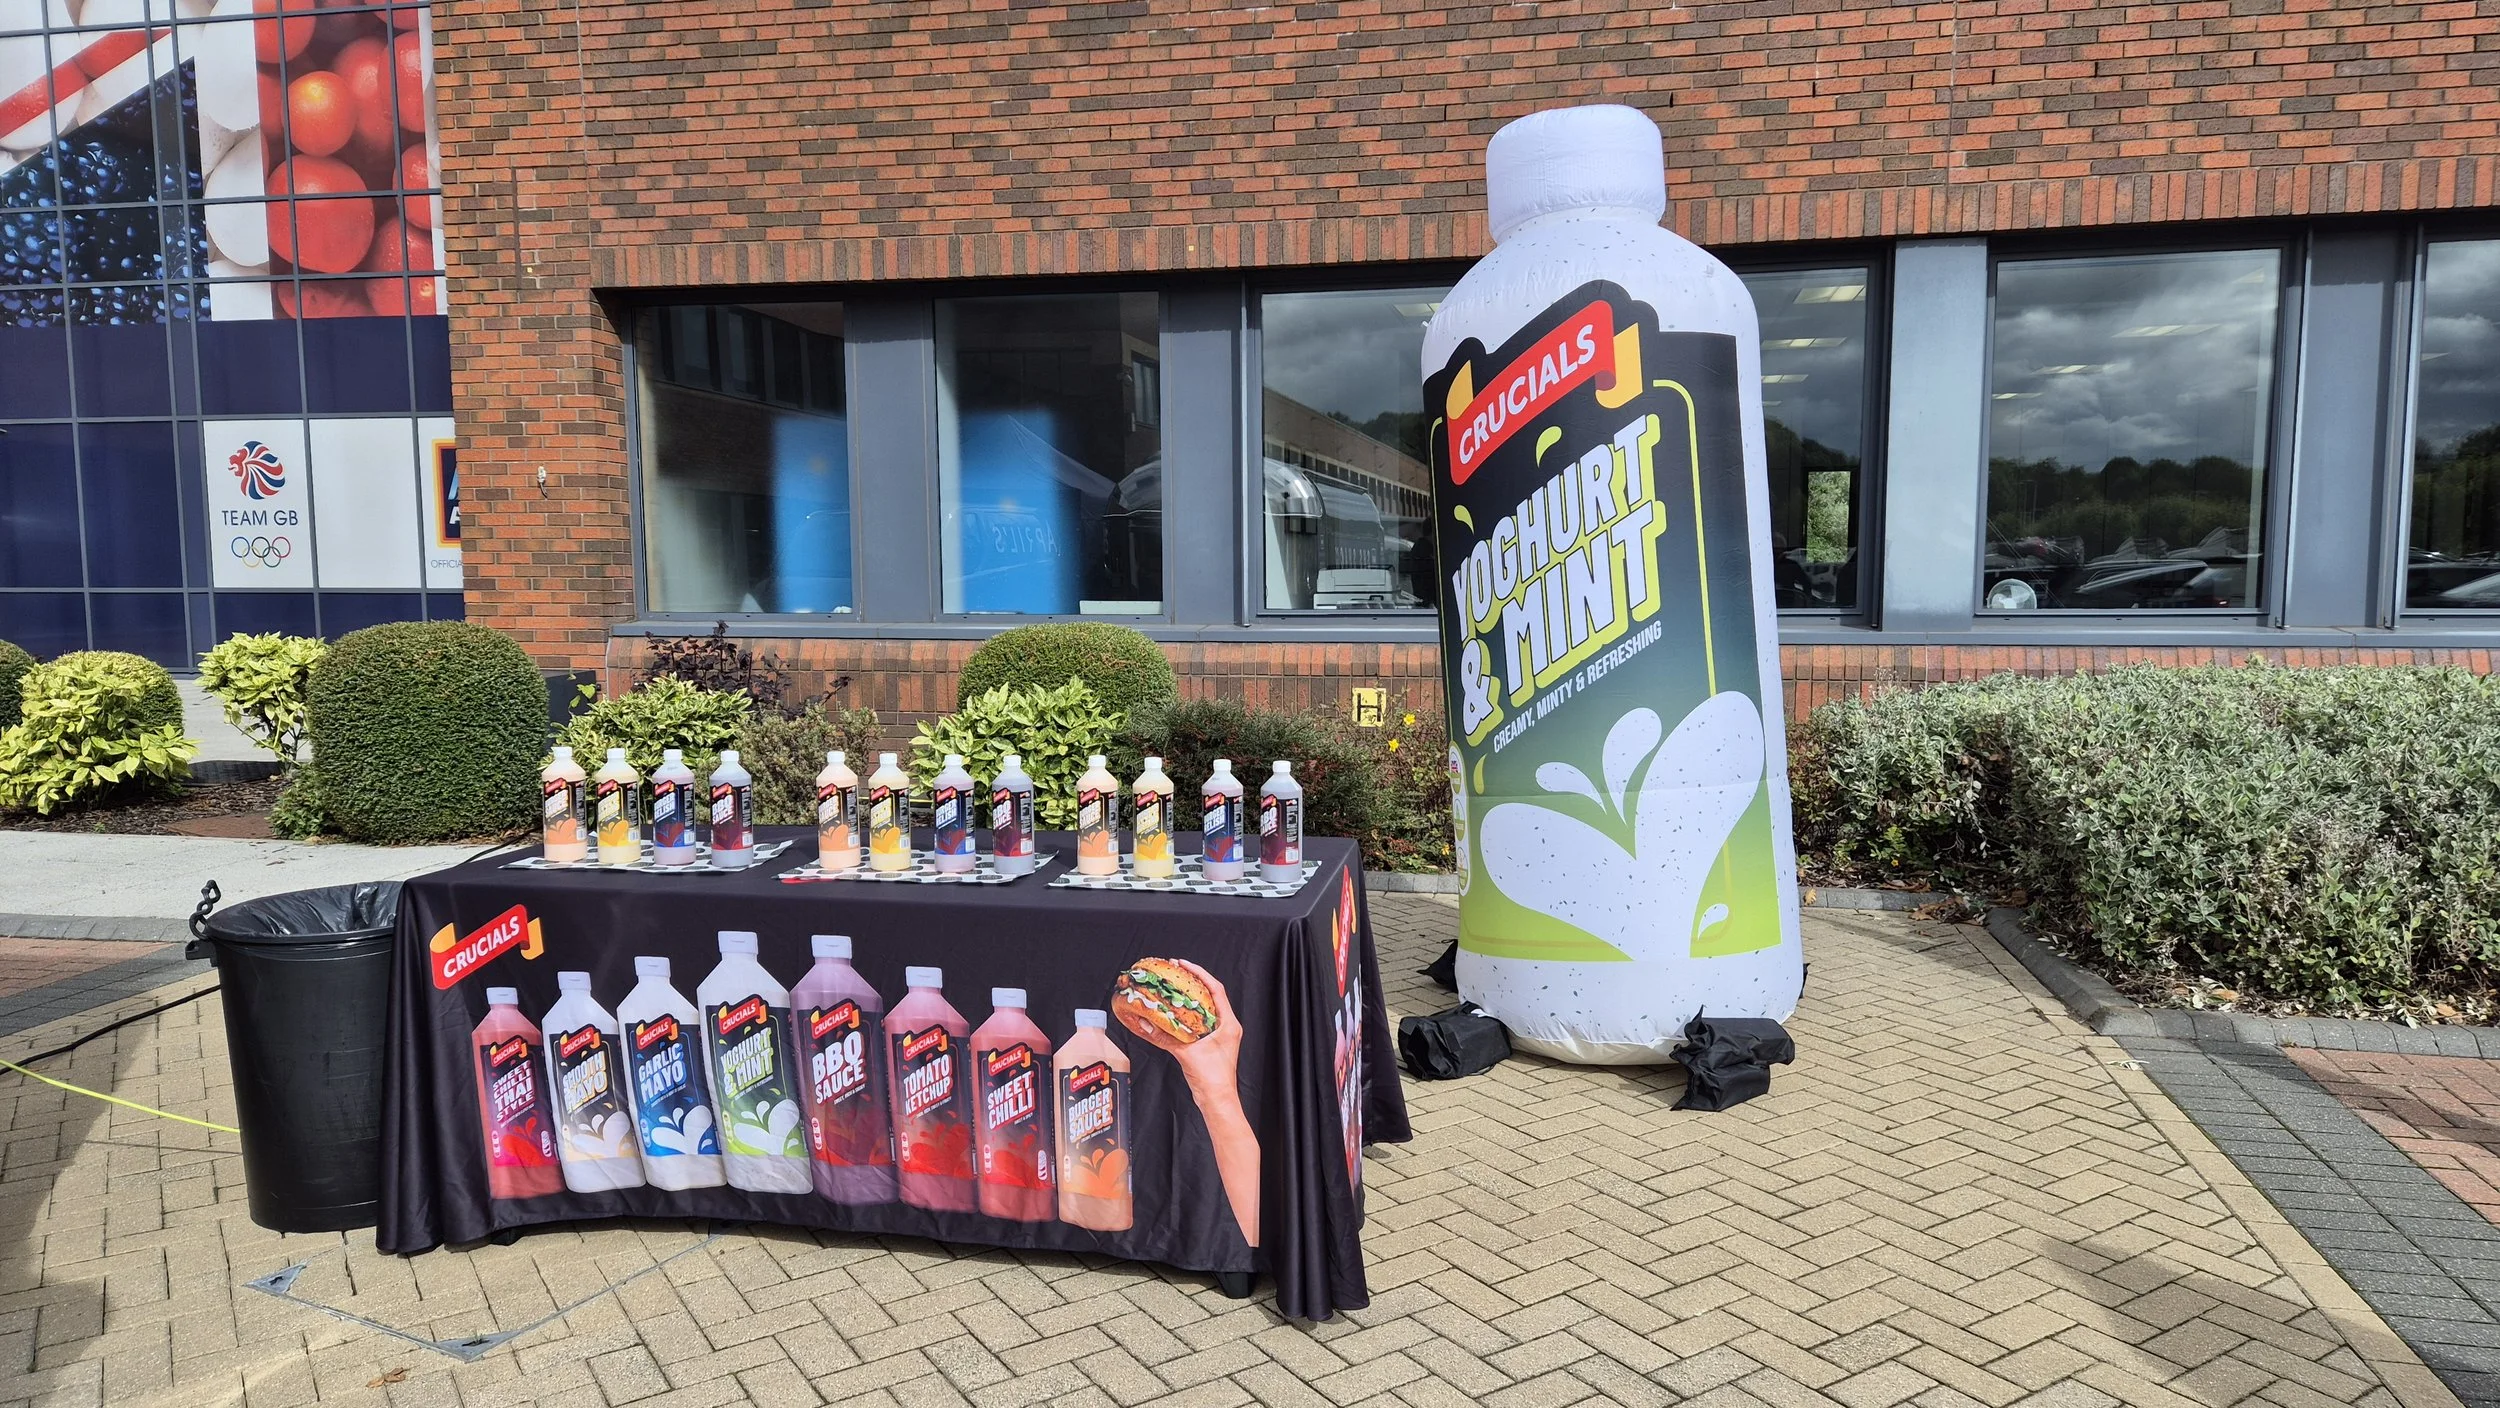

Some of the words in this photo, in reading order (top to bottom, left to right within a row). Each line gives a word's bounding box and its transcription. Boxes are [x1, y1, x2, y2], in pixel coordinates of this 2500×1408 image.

[1459, 323, 1596, 465] CRUCIALS
[222, 509, 268, 526] TEAM
[273, 509, 299, 526] GB
[1451, 414, 1648, 642] YOGHURT
[1461, 638, 1494, 737] &
[1501, 499, 1654, 697] MINT
[1357, 692, 1382, 722] H
[1493, 707, 1535, 754] CREAMY,
[1536, 678, 1573, 720] MINTY
[1575, 671, 1585, 693] &
[1587, 620, 1662, 685] REFRESHING
[443, 915, 520, 978] CRUCIALS
[640, 1021, 669, 1046] CRUCIALS
[722, 1003, 757, 1030] CRUCIALS
[814, 1007, 849, 1035] CRUCIALS
[638, 1043, 683, 1082] GARLIC
[720, 1027, 771, 1074] YOGHURT
[812, 1031, 862, 1085] BBQ
[905, 1032, 939, 1057] CRUCIALS
[991, 1049, 1022, 1073] CRUCIALS
[492, 1060, 531, 1091] SWEET
[493, 1068, 532, 1100] CHILLI
[640, 1060, 684, 1104] MAYO
[735, 1047, 772, 1087] MINT
[815, 1058, 864, 1104] SAUCE
[903, 1054, 950, 1098] TOMATO
[494, 1076, 533, 1112] THAI
[496, 1090, 534, 1123] STYLE
[563, 1071, 607, 1115] MAYO
[905, 1076, 951, 1116] KETCHUP
[987, 1070, 1033, 1111] SWEET
[988, 1087, 1034, 1130] CHILLI
[1068, 1087, 1111, 1125] BURGER
[1069, 1103, 1111, 1144] SAUCE
